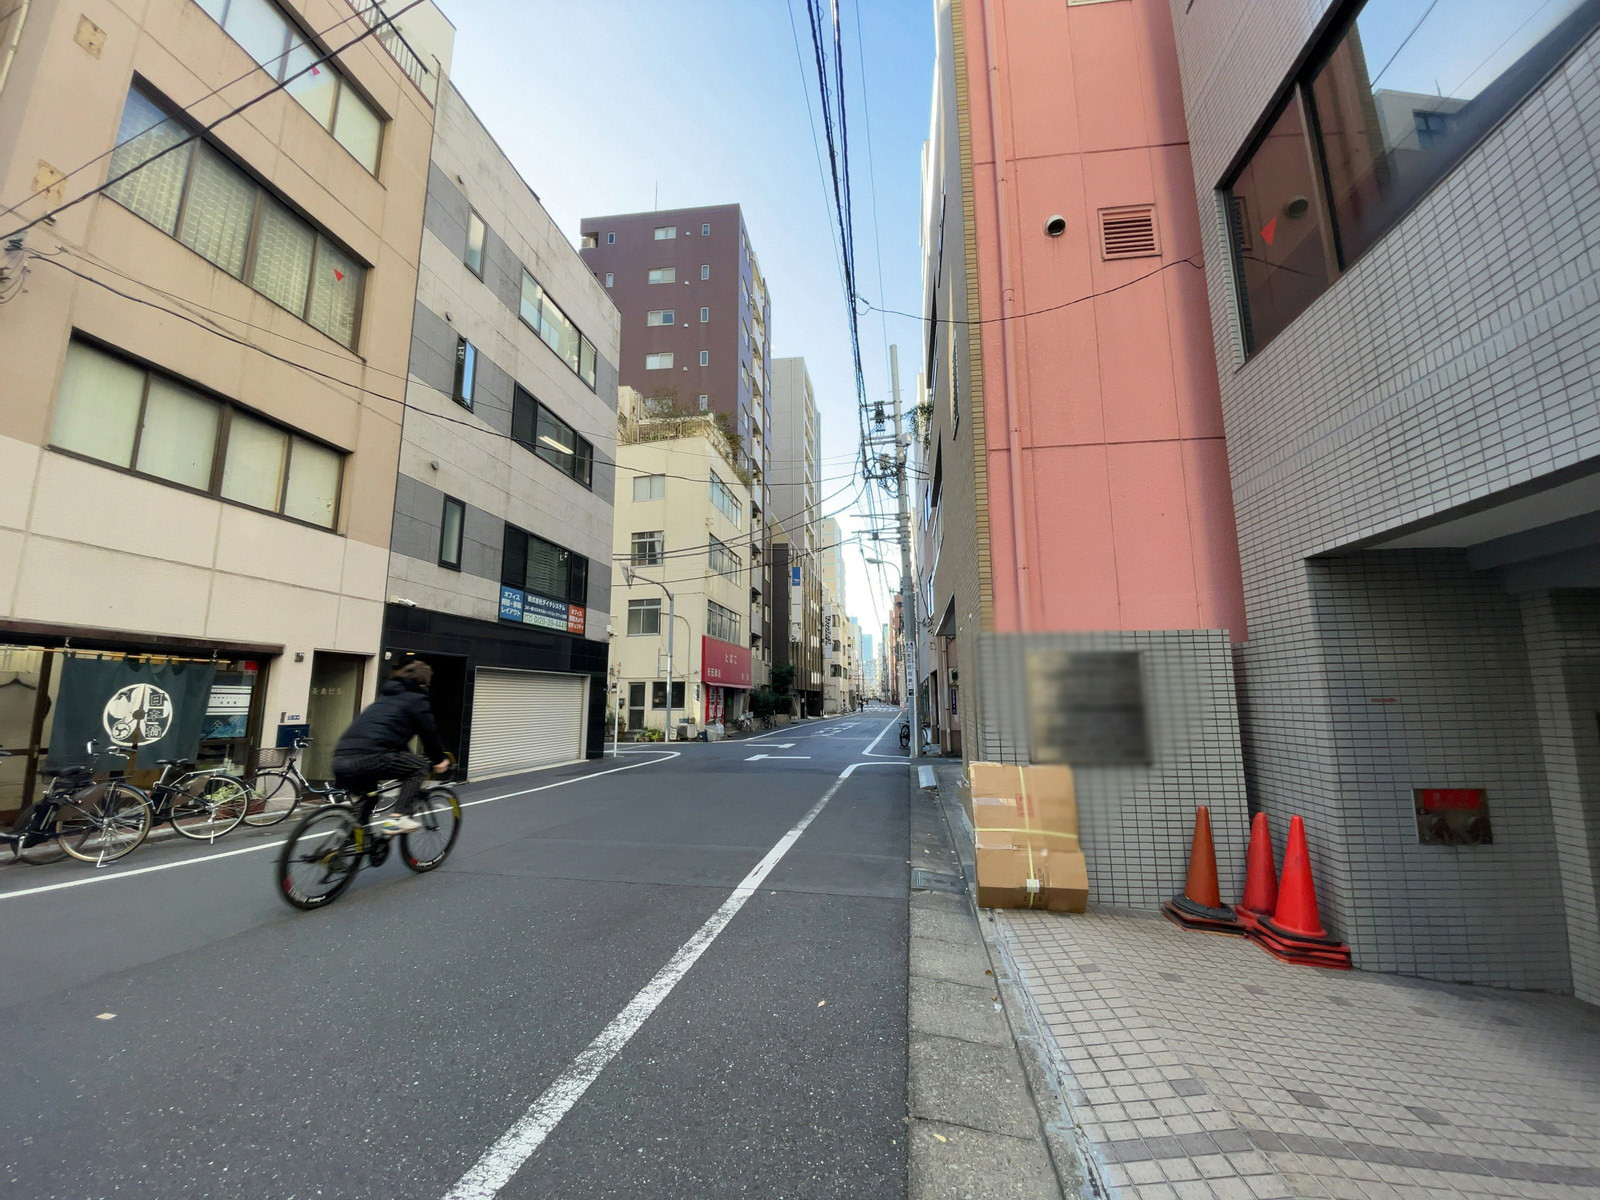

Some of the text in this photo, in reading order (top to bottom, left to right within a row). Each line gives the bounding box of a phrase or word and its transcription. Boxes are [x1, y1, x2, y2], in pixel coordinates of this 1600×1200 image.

[503, 591, 521, 601] オフィス
[502, 606, 521, 616] レイアウト
